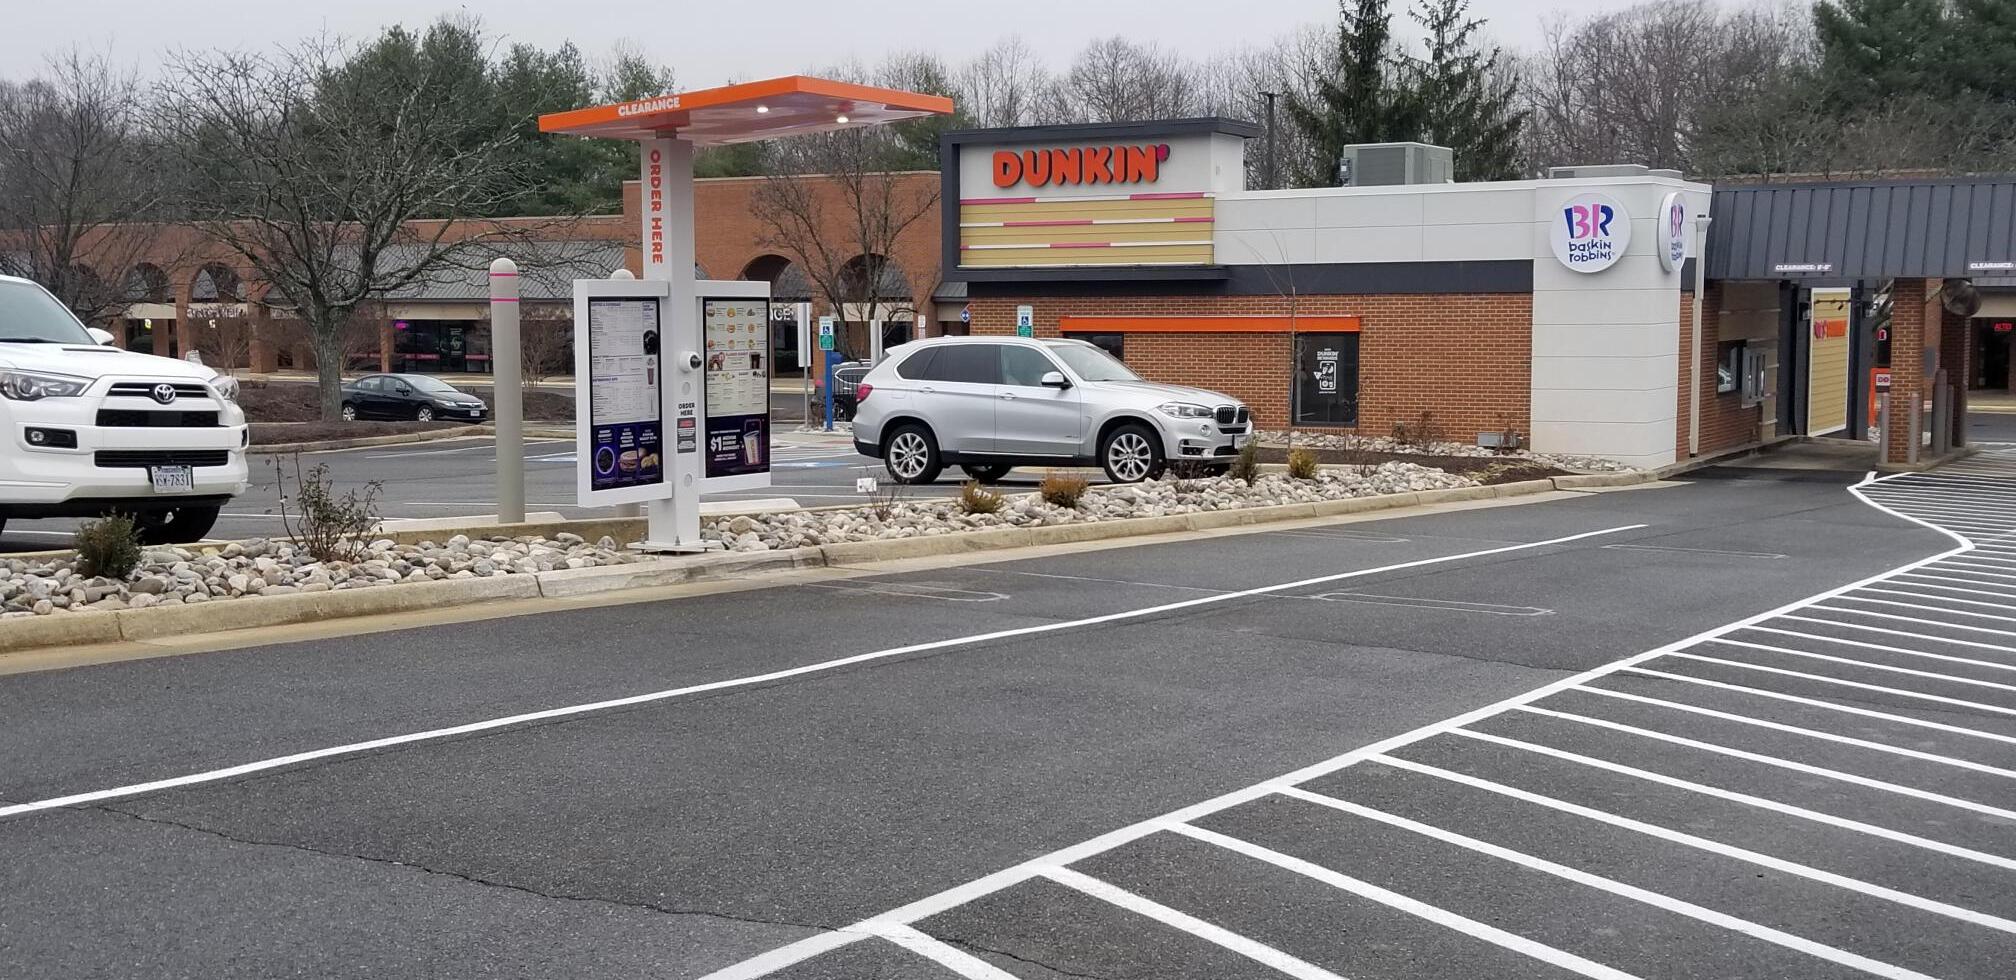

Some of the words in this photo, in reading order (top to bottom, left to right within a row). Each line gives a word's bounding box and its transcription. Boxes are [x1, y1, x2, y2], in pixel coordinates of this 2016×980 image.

[618, 97, 681, 117] CLEARANCE
[650, 149, 662, 212] ORDER
[992, 144, 1170, 188] DUNKIN'
[1564, 203, 1614, 239] BR
[1670, 204, 1684, 238] BR
[651, 217, 663, 264] HERE
[1568, 239, 1612, 252] baskin
[1569, 250, 1612, 263] robbins
[710, 436, 722, 452] $1
